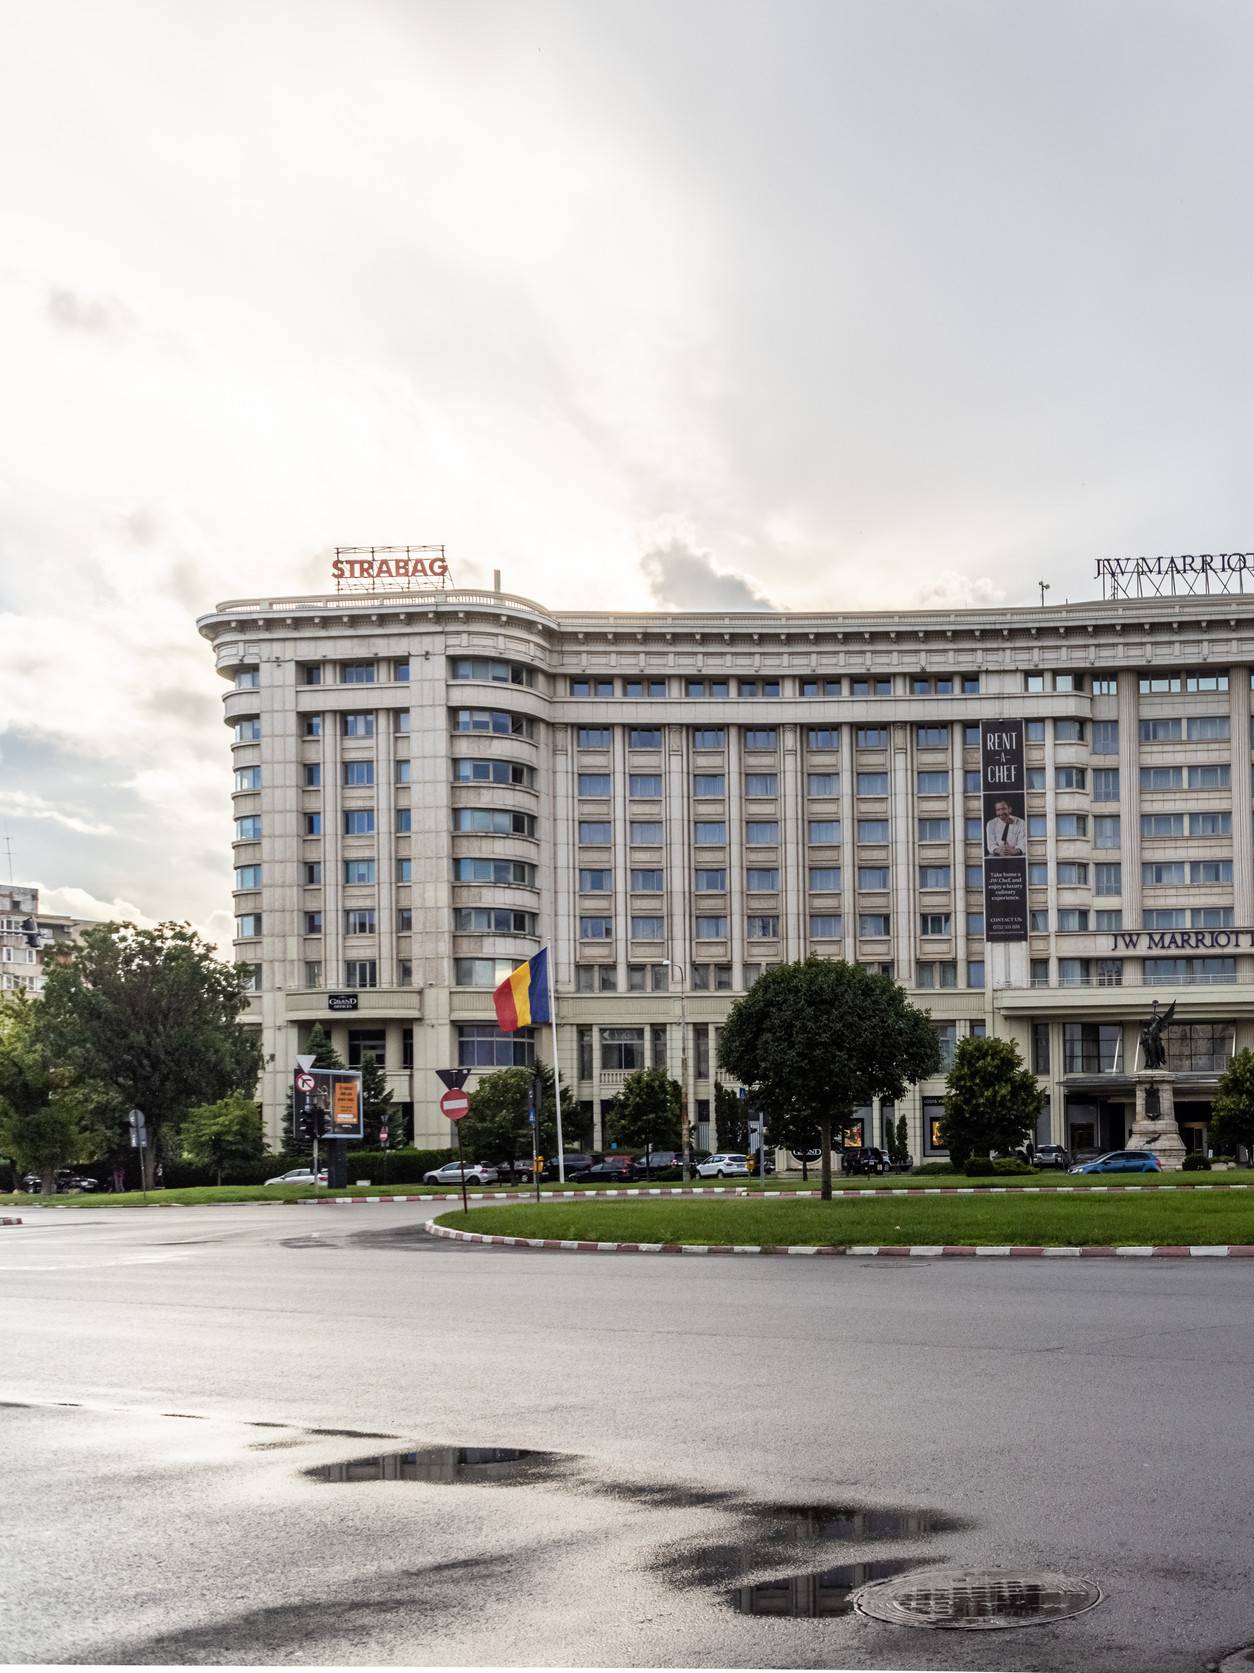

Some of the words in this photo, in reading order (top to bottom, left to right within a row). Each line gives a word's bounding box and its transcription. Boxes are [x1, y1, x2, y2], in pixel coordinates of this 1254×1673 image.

[331, 558, 448, 578] STRABAG
[1094, 558, 1130, 579] JW
[987, 732, 1017, 750] RENT
[1001, 752, 1006, 763] A
[988, 765, 1018, 783] CHEF
[1112, 933, 1141, 951] JW
